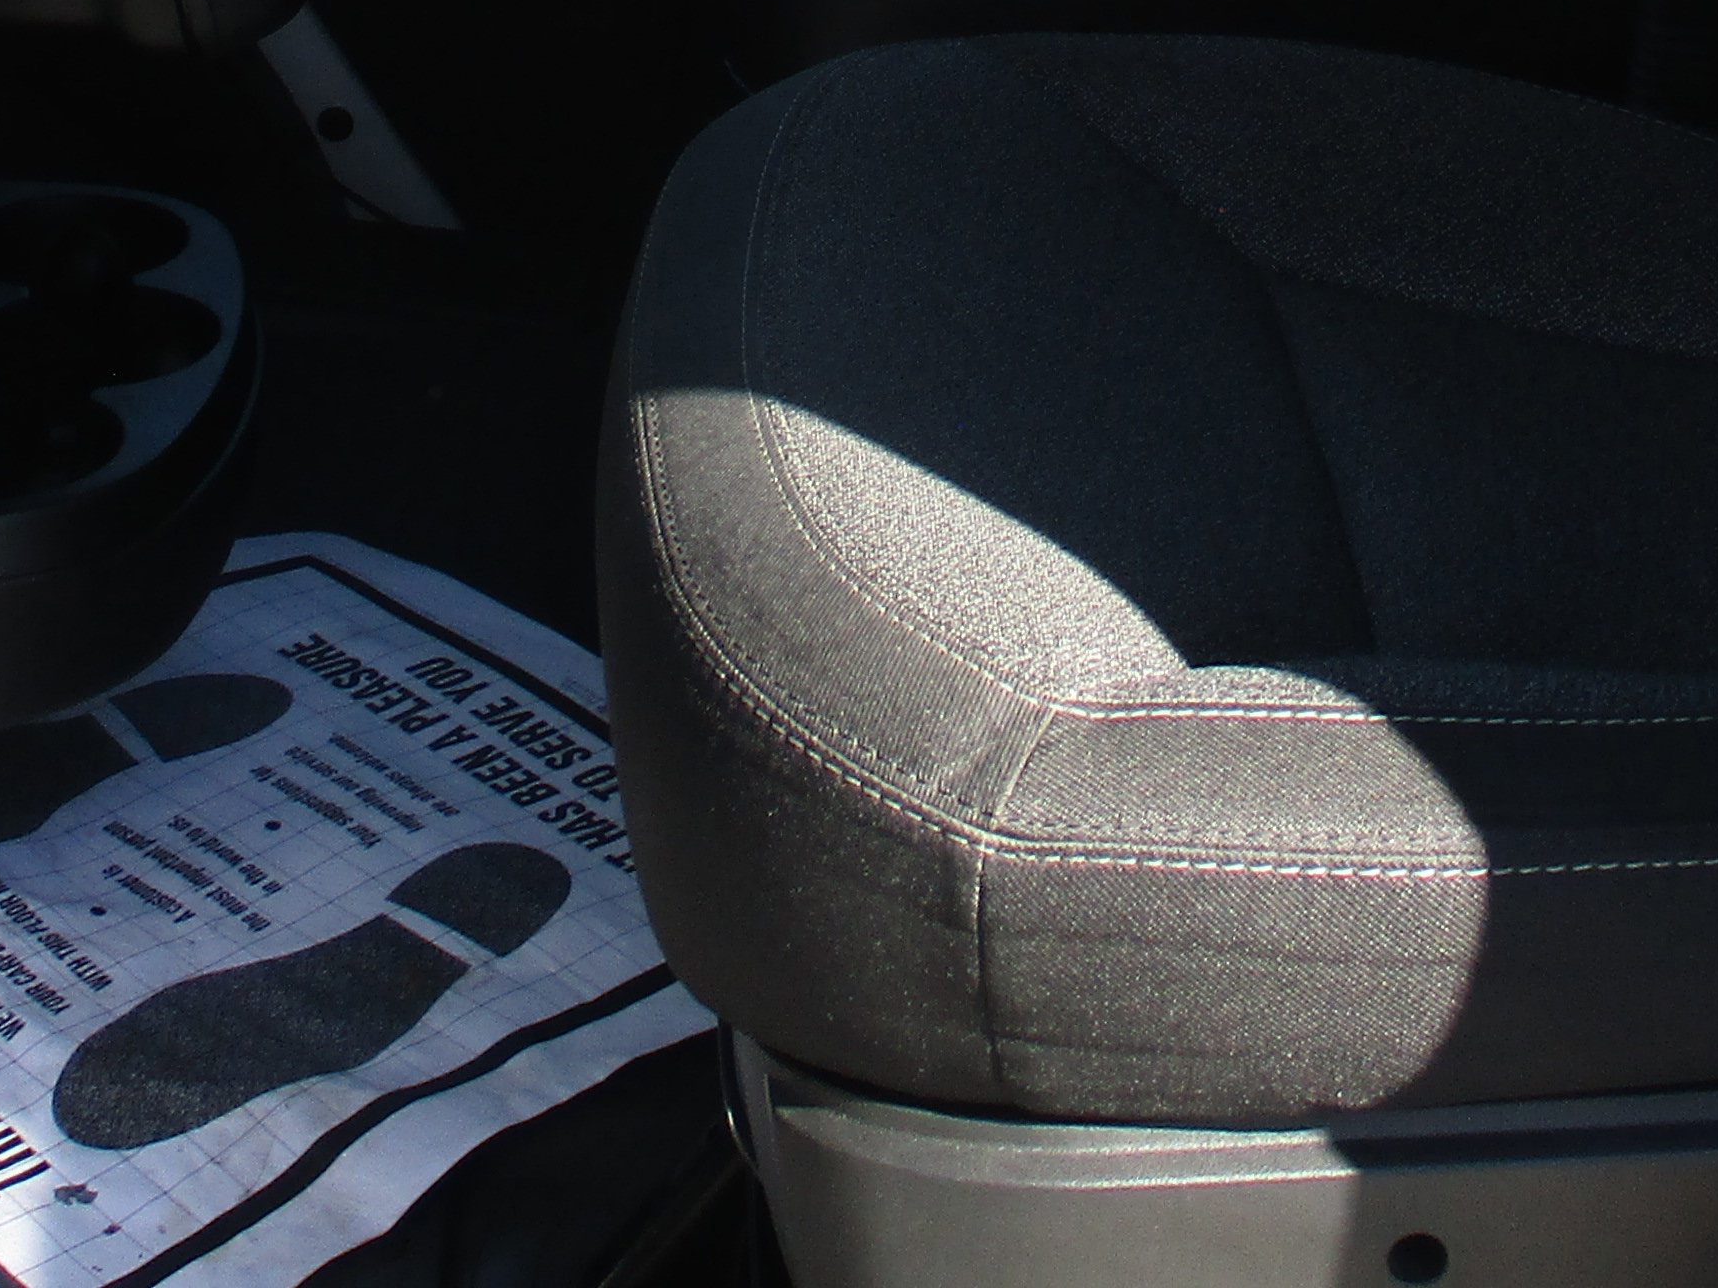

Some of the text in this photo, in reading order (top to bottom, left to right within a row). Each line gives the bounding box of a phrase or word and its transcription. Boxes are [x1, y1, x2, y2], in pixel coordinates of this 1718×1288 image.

[402, 652, 620, 803] TO SERVE YOU
[274, 631, 637, 876] T HAS BEEN A PLEASURE
[247, 763, 279, 784] for
[329, 772, 361, 792] our
[429, 797, 461, 818] are
[183, 825, 209, 843] to
[345, 822, 382, 851] Your
[194, 835, 246, 867] world
[100, 818, 272, 935] the most important person
[234, 861, 271, 888] the
[258, 878, 285, 898] in
[99, 861, 197, 925] A customer is
[34, 930, 79, 962] THIS
[63, 952, 114, 994] WITH
[22, 979, 73, 1017] YOUR
